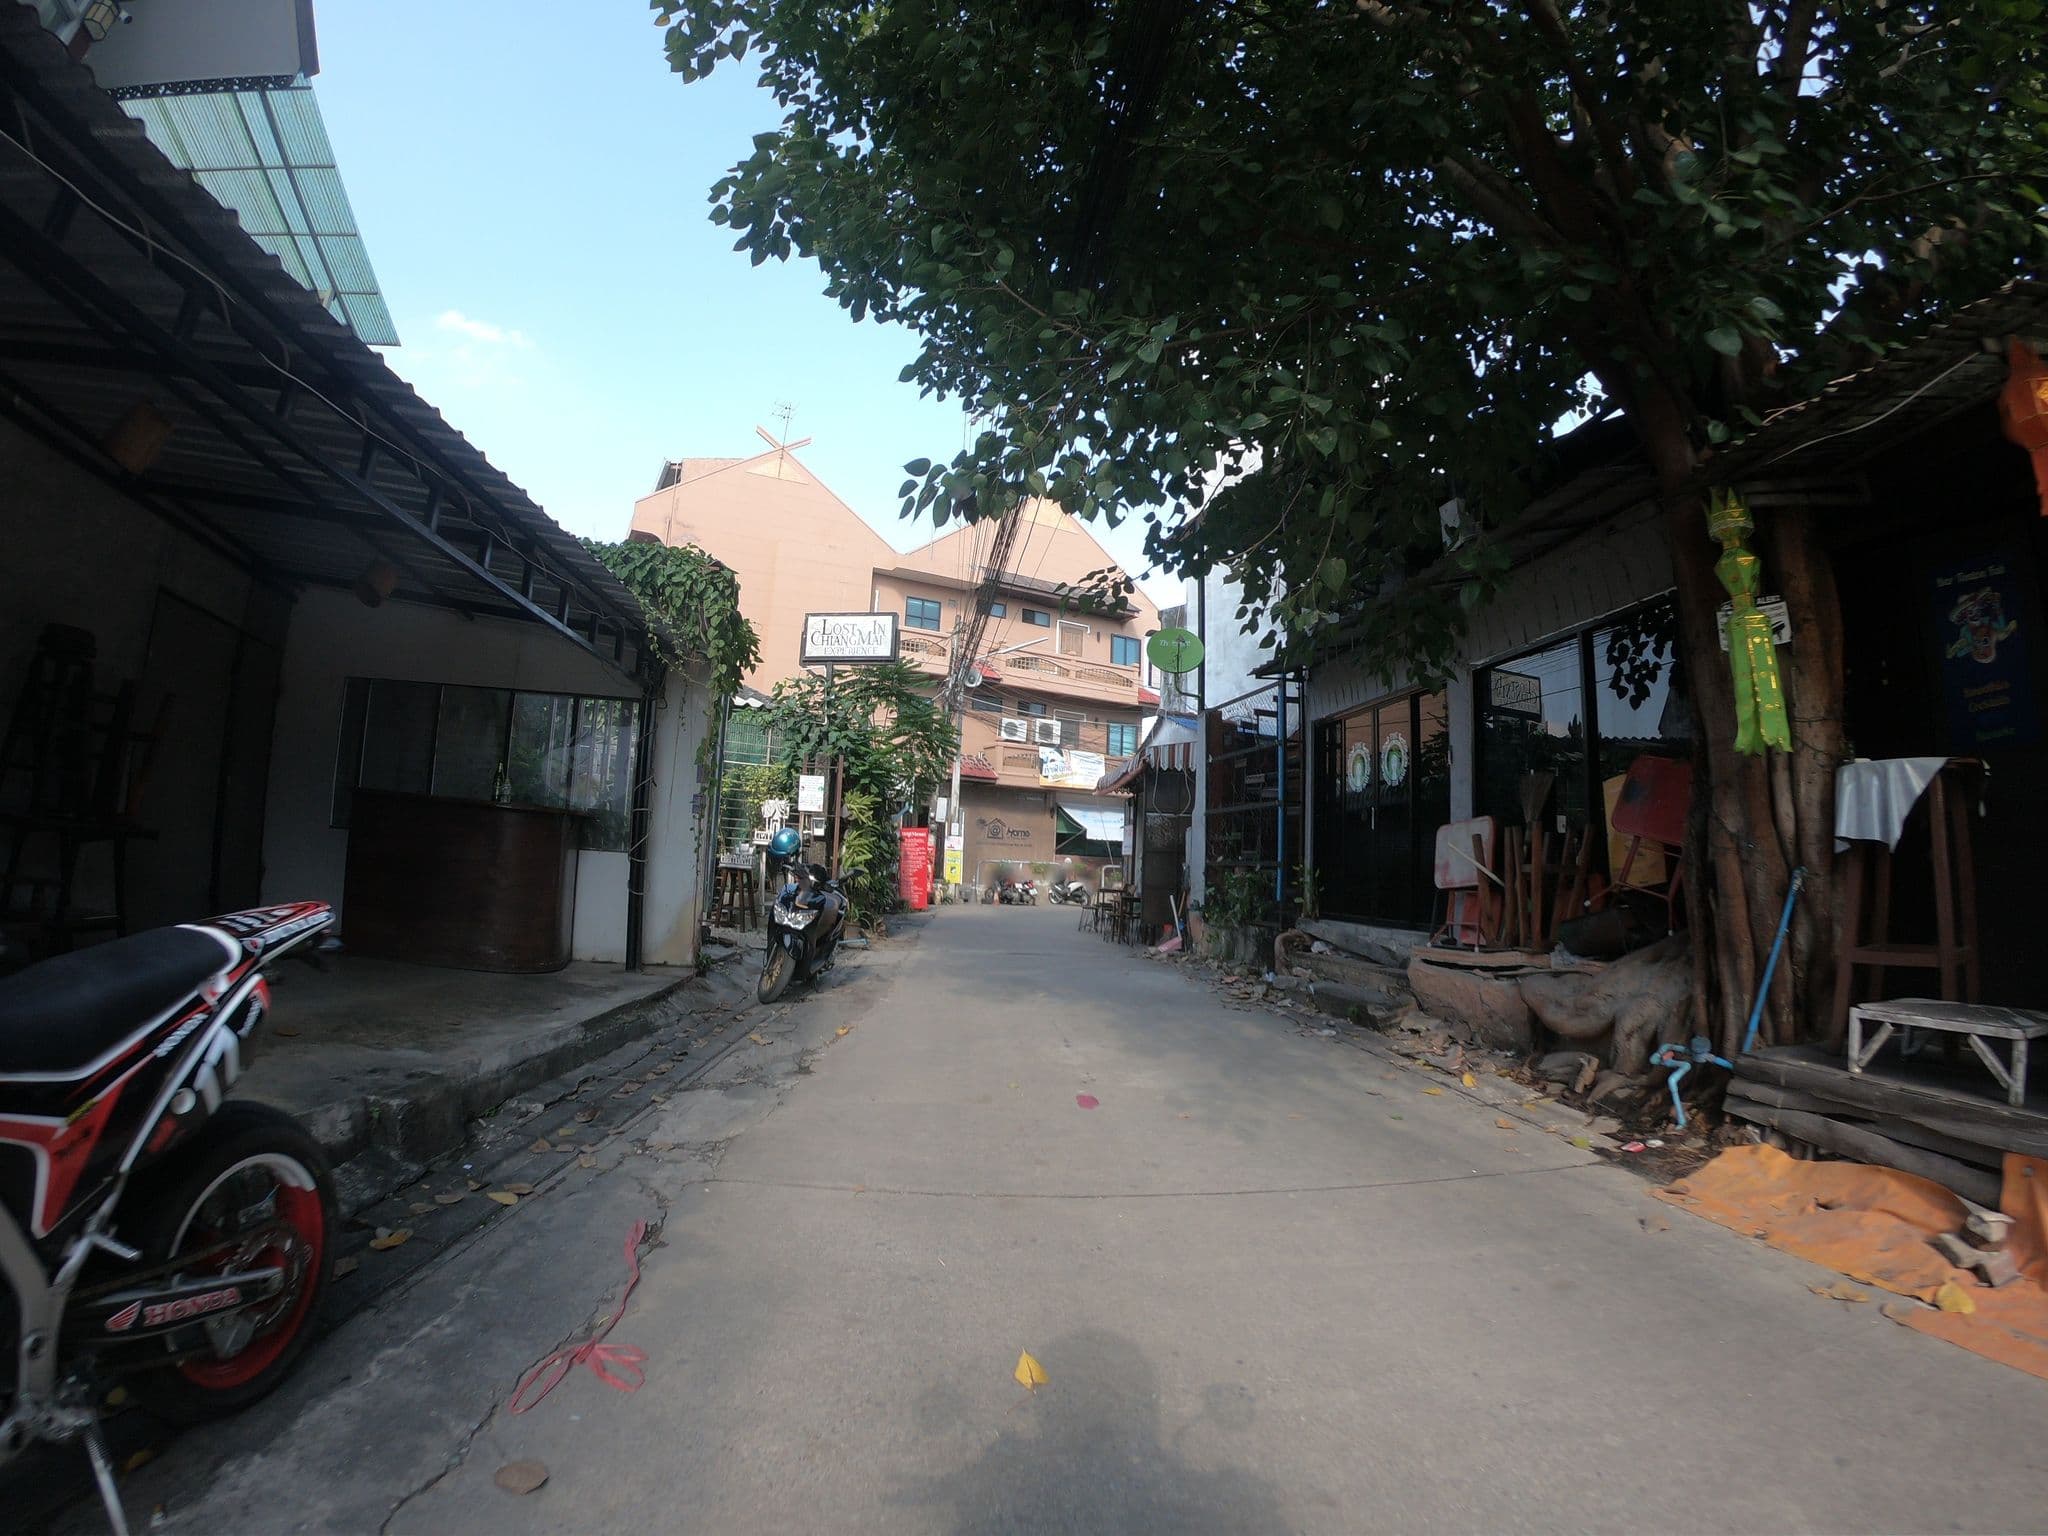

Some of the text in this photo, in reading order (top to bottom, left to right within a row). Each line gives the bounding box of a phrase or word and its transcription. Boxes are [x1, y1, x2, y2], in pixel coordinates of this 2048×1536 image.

[821, 619, 887, 637] LOST IN
[823, 646, 879, 656] EXPERIENCE
[142, 1287, 241, 1327] HONDA
